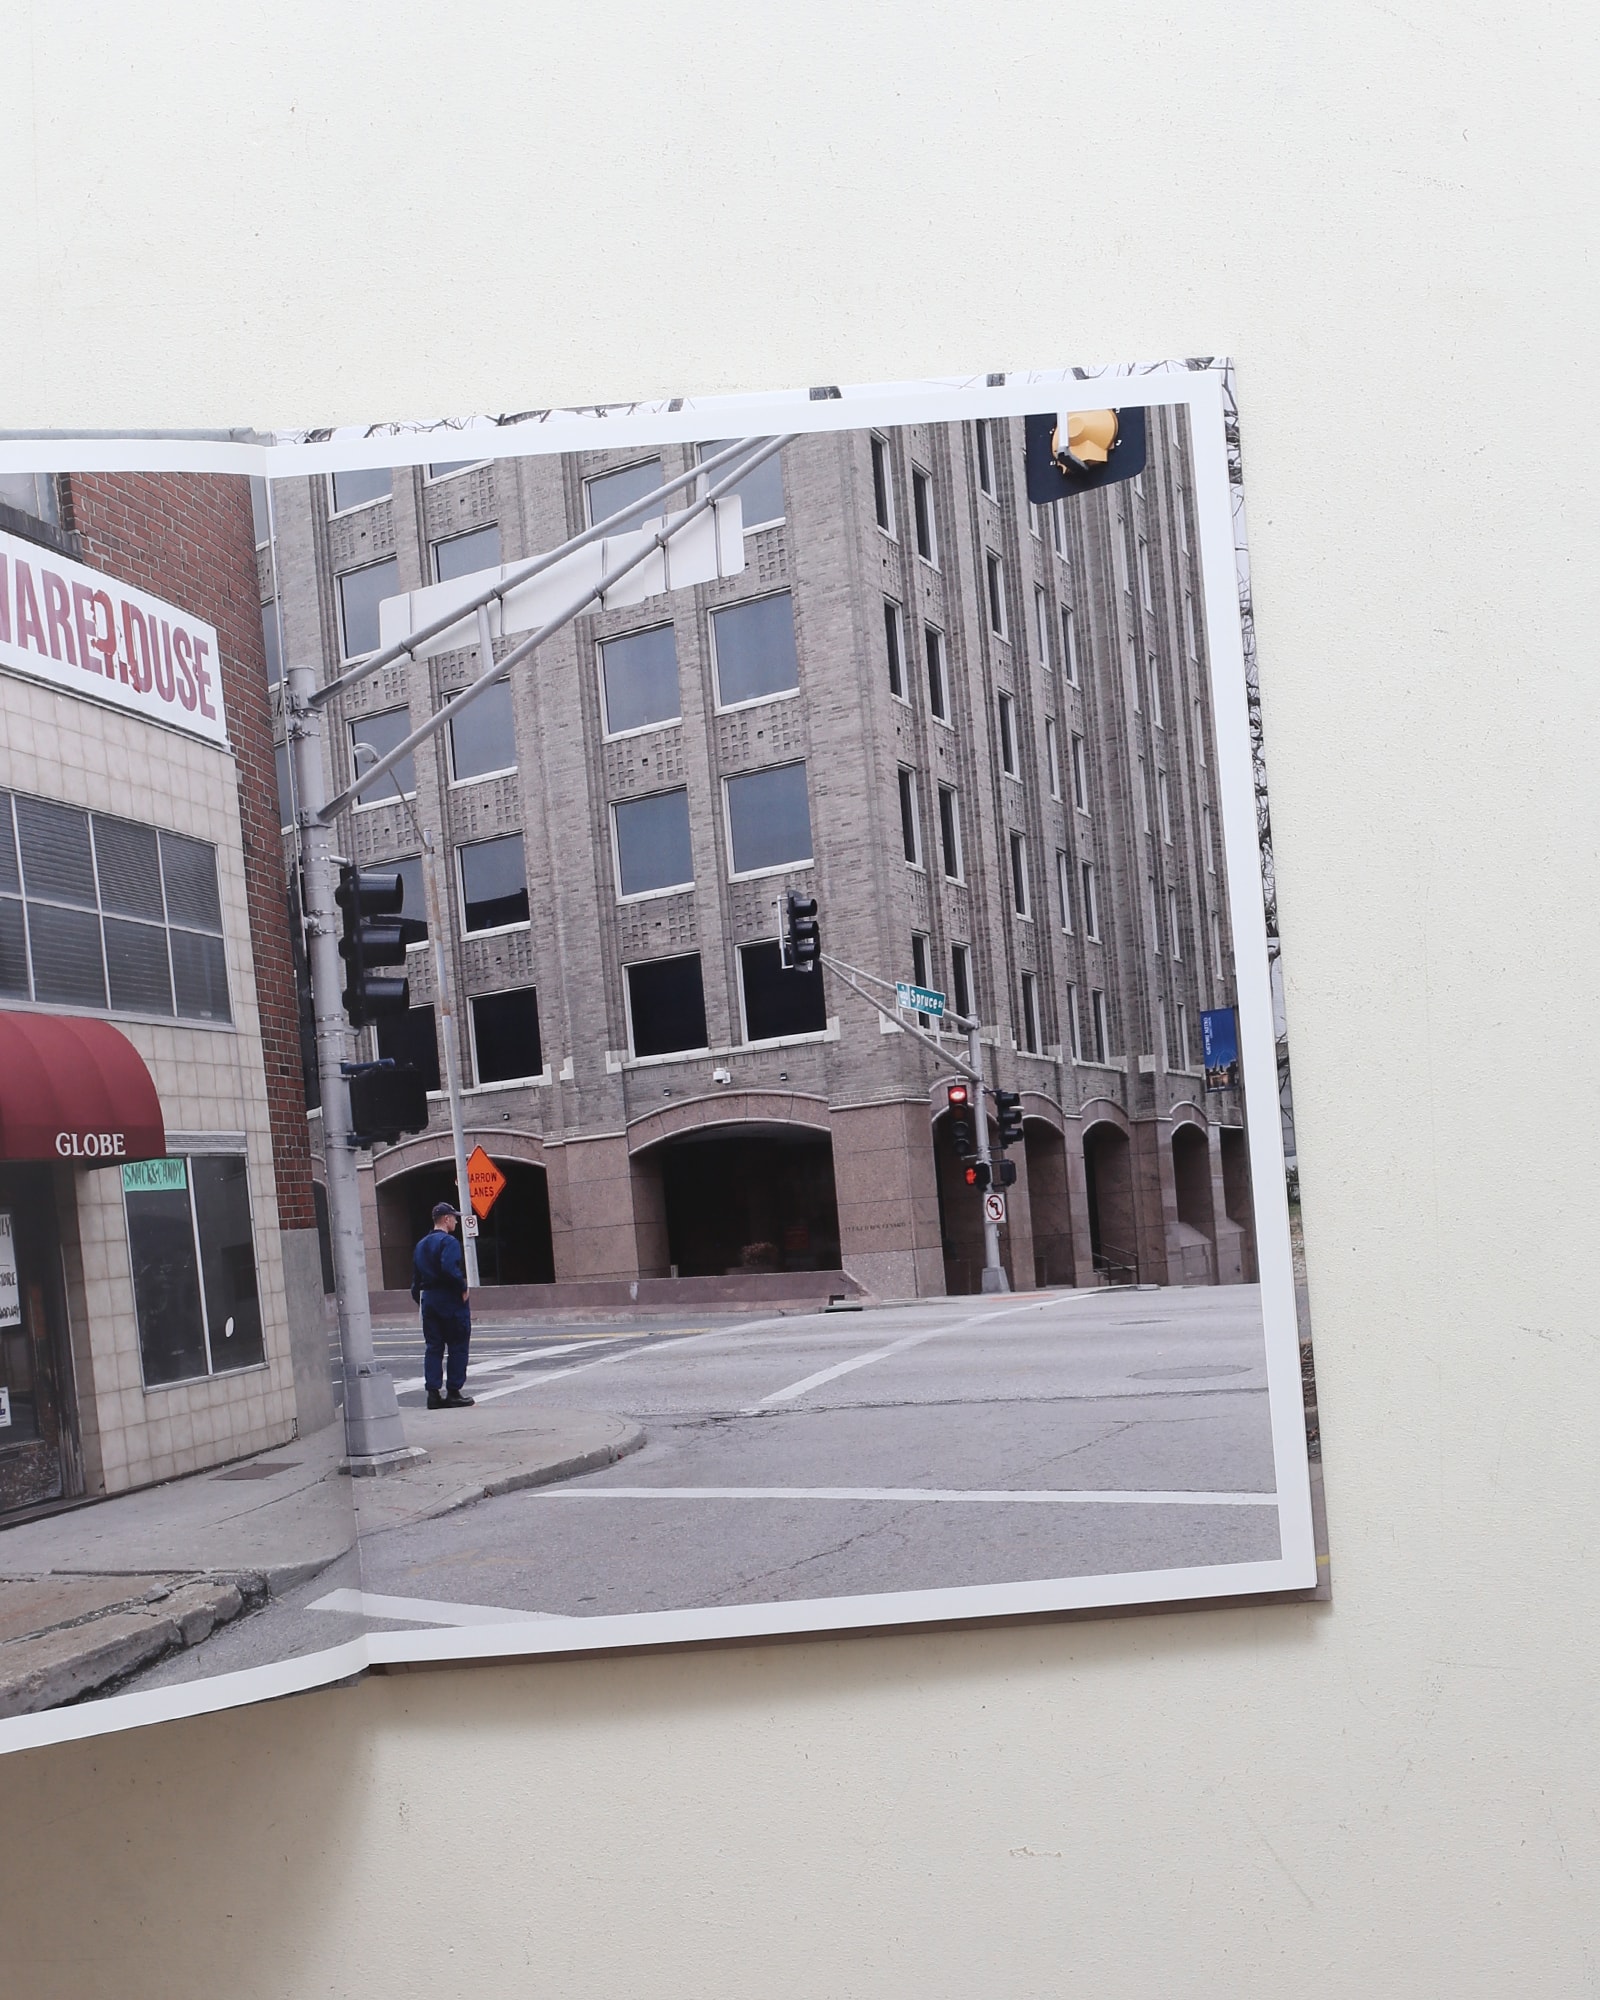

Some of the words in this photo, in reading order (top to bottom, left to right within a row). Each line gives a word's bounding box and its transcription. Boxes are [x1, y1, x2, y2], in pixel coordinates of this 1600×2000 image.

[0, 552, 216, 721] AREOUSE
[911, 989, 937, 1009] Spruce
[55, 1132, 126, 1156] GLOBE
[468, 1172, 497, 1183] ARROW
